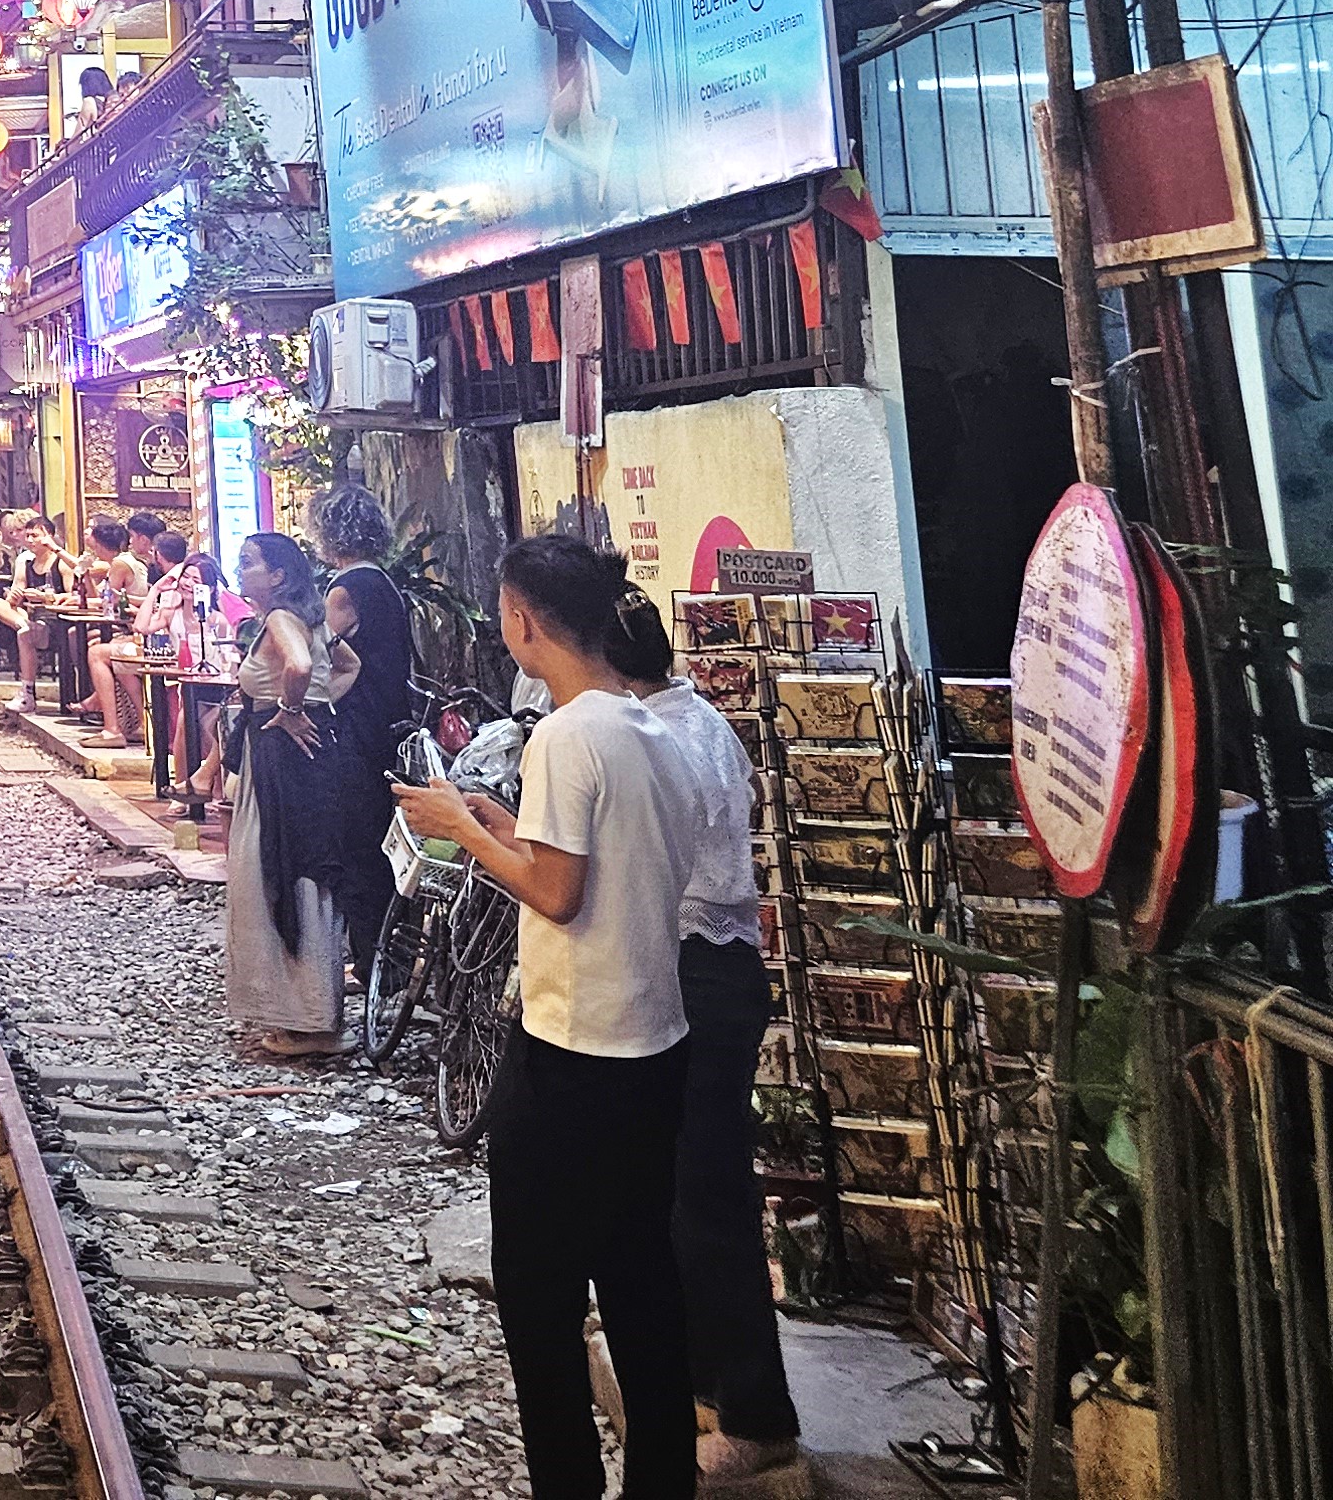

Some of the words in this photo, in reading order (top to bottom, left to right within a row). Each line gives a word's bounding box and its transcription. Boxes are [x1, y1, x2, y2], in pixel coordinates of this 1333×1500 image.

[715, 36, 735, 59] dental
[736, 28, 762, 50] service
[762, 23, 772, 40] in
[771, 12, 805, 36] Vietnam
[699, 73, 738, 101] CONNECT
[739, 69, 752, 87] US
[753, 63, 767, 83] ON
[333, 98, 359, 177] The
[354, 108, 382, 151] Best
[381, 84, 417, 139] Dental
[416, 84, 431, 115] in
[433, 59, 472, 111] Hanoi
[473, 49, 495, 90] for
[496, 45, 507, 77] u
[95, 237, 125, 321] Tiger
[638, 465, 656, 489] BACK
[628, 522, 658, 540] VIETNAM
[723, 552, 807, 572] POSTCARD
[732, 569, 776, 584] 10.000
